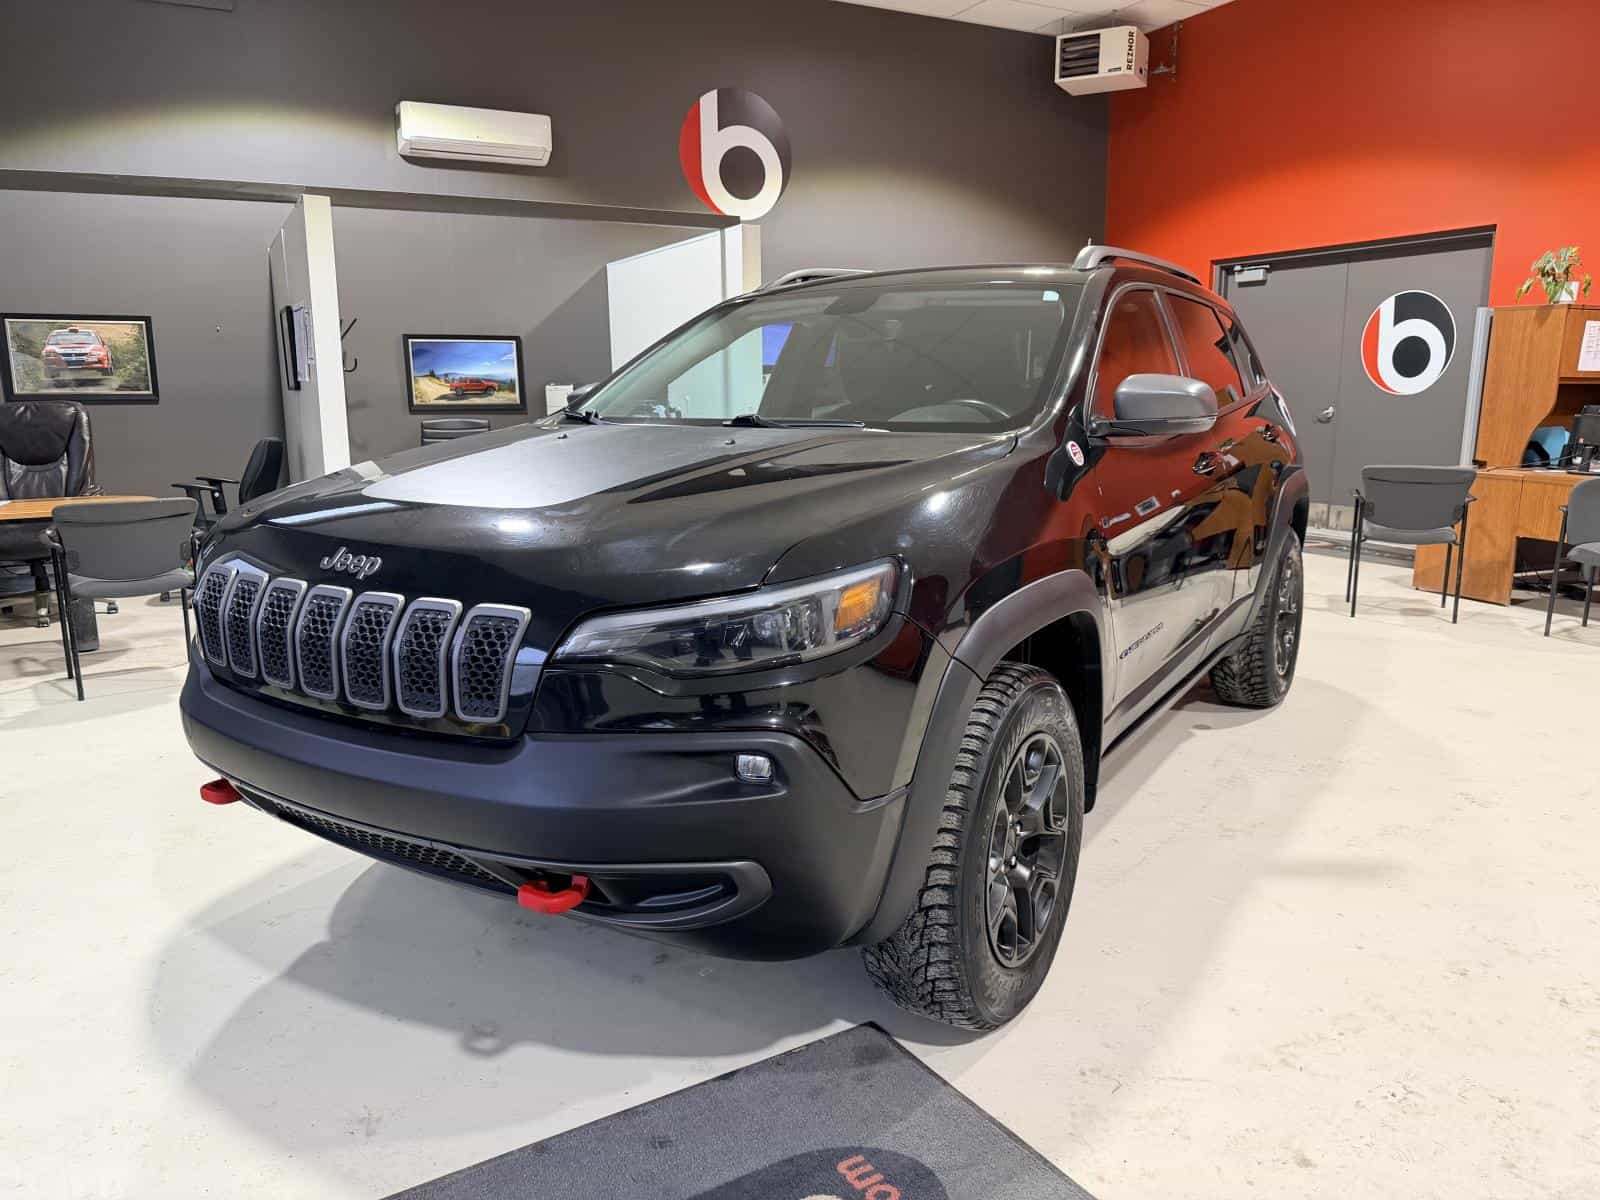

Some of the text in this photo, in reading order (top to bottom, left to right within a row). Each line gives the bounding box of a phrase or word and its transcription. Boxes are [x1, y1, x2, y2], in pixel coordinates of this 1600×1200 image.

[1126, 31, 1135, 70] REZNOR
[700, 88, 783, 220] b
[1377, 294, 1447, 395] b
[320, 546, 382, 579] Jeep
